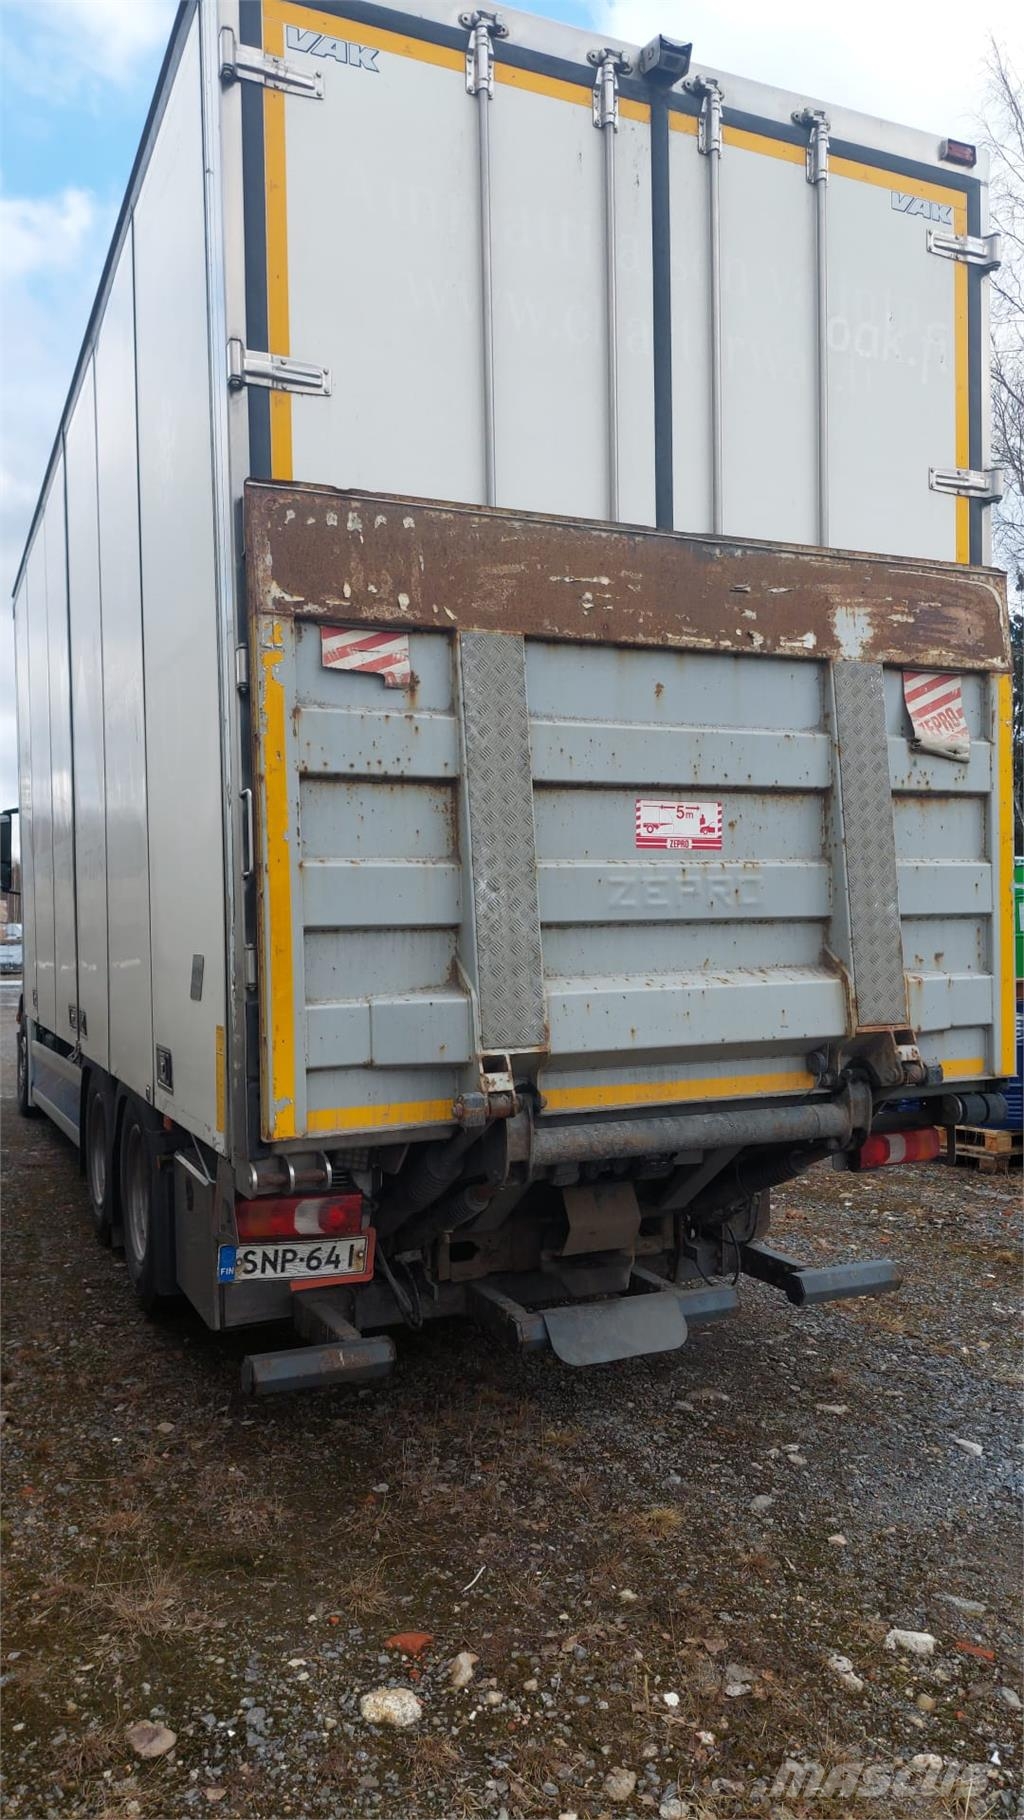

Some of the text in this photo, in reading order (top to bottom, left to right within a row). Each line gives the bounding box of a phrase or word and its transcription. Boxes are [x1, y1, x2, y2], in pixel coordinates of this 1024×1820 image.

[286, 25, 380, 73] VAK
[891, 191, 952, 225] VAK
[669, 840, 690, 848] ZEPRO
[220, 1267, 235, 1275] FIN
